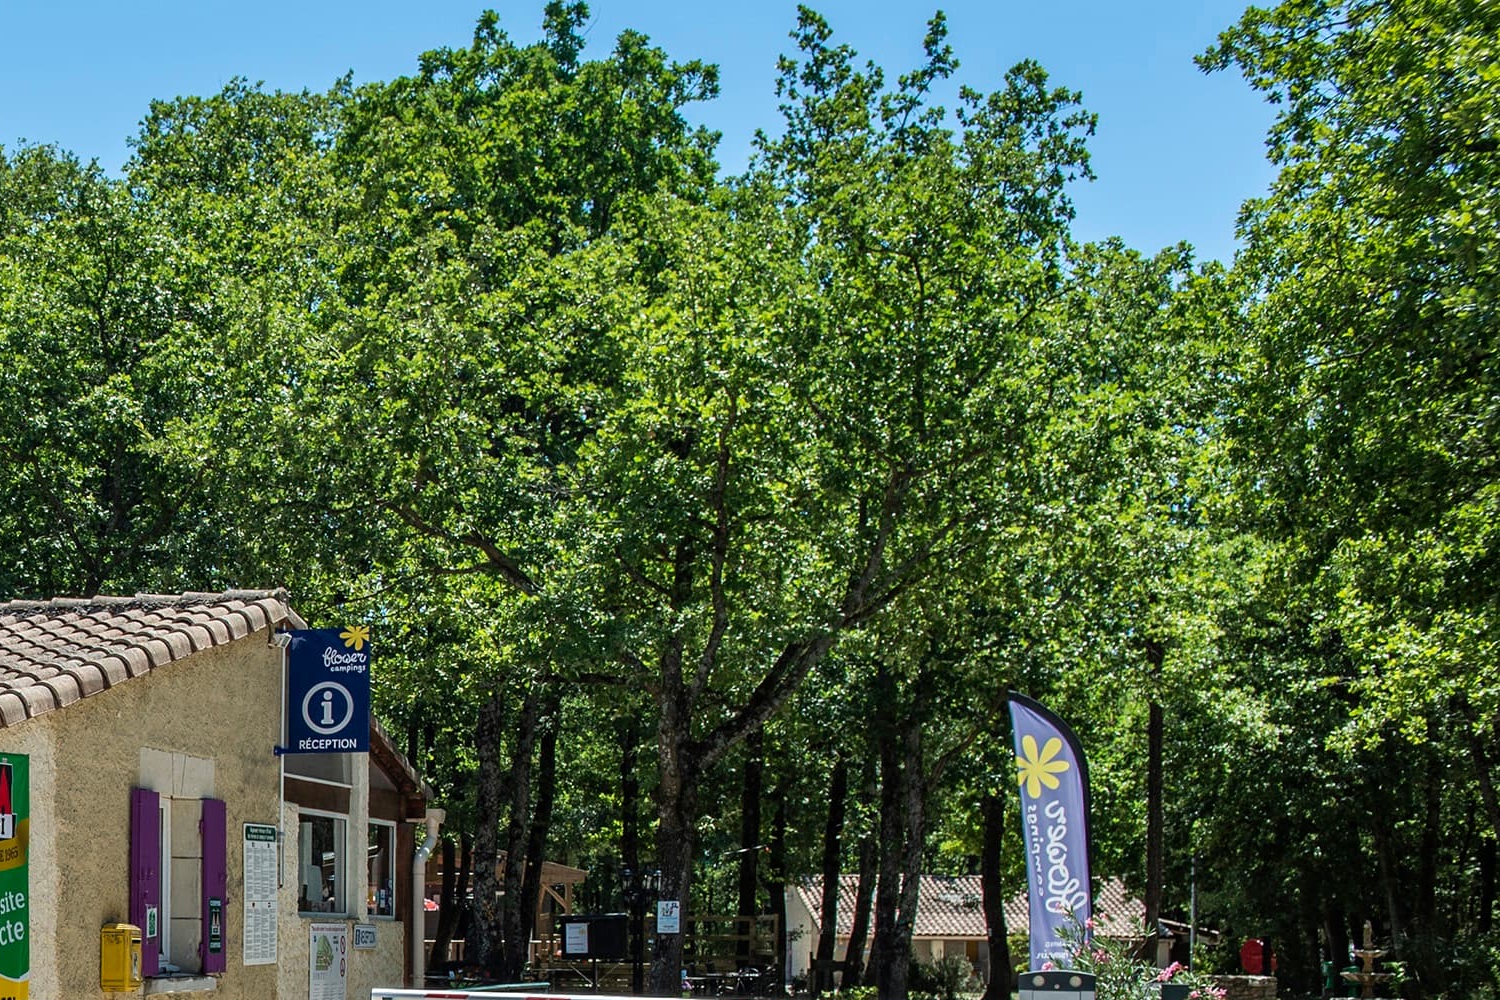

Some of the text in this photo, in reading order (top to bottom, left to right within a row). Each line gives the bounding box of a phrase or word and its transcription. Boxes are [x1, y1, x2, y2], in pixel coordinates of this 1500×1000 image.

[322, 646, 367, 668] flower
[330, 663, 366, 674] campings
[299, 737, 357, 750] RÉCEPTION
